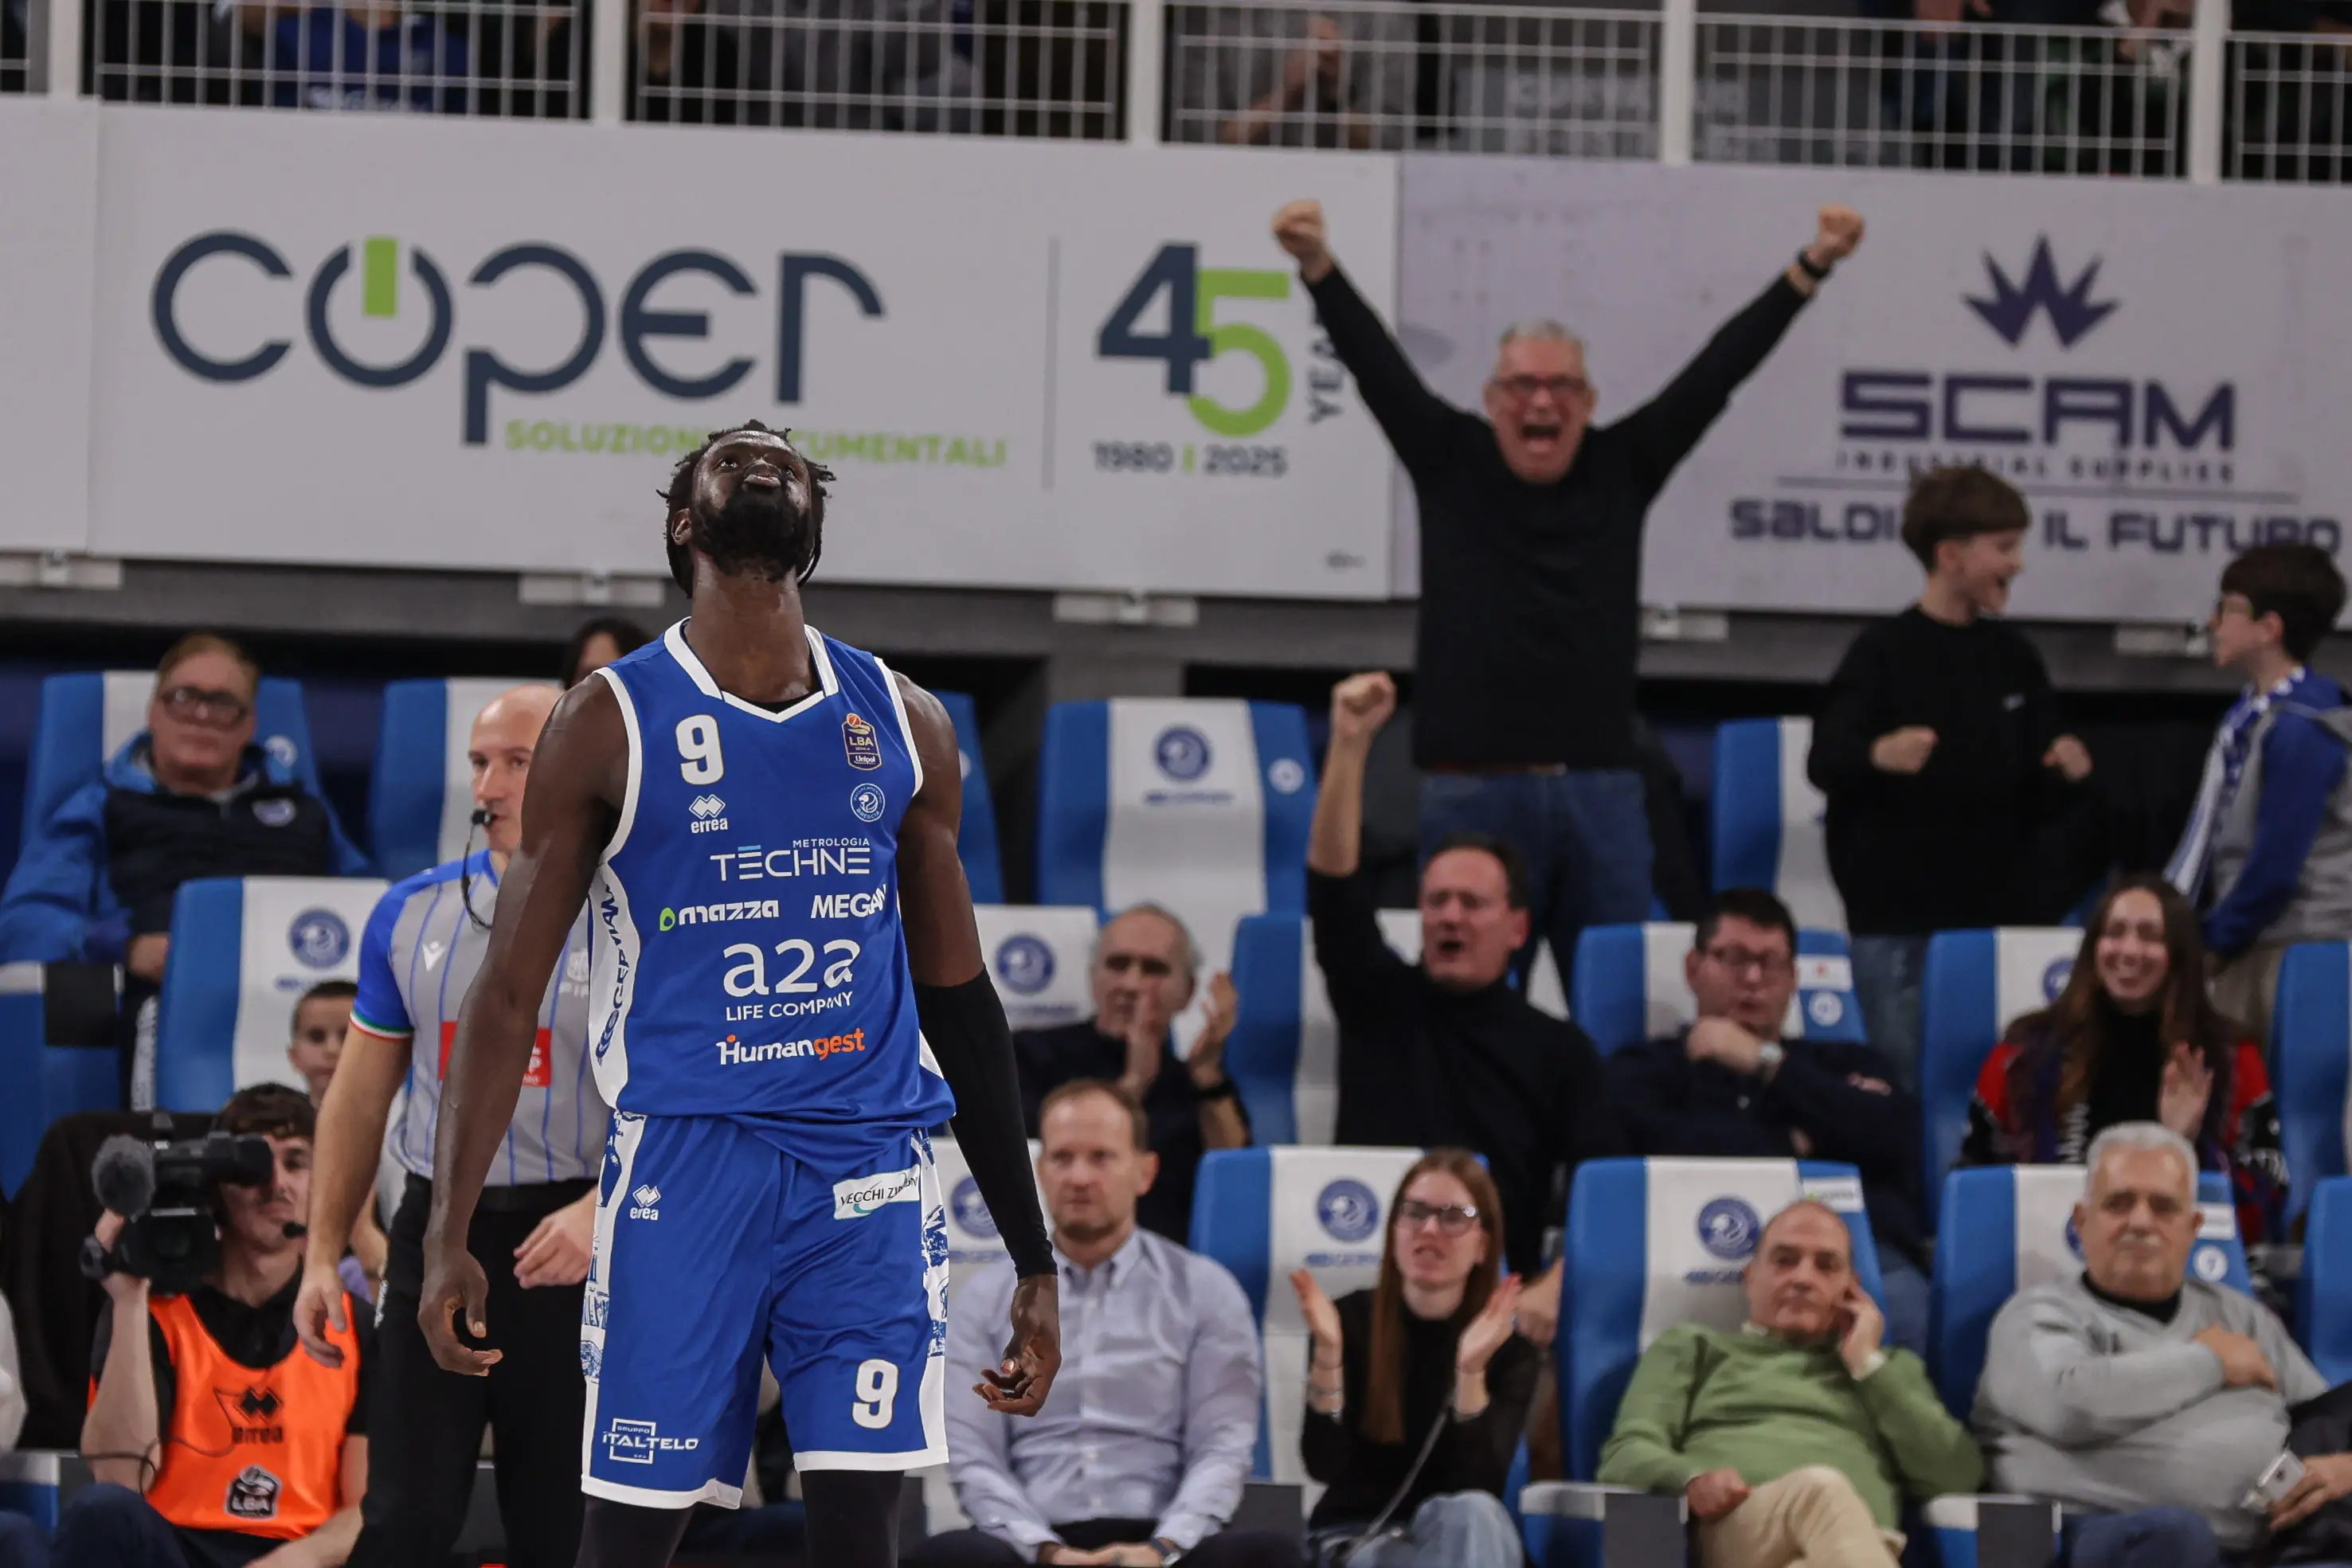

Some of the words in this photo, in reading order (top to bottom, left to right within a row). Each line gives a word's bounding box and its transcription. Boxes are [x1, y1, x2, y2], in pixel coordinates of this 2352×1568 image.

[1098, 243, 1292, 438] 45
[1840, 370, 2235, 452] SCAM
[505, 420, 714, 455] SOLUZION
[787, 430, 1007, 468] CUMENTALI
[1094, 441, 1172, 473] 1980
[1204, 443, 1287, 478] 2025
[2042, 512, 2088, 549] IL
[2111, 511, 2340, 556] FUTURO
[675, 714, 724, 785] 9
[849, 737, 875, 747] LBA
[855, 755, 876, 765] Unipol
[691, 818, 728, 834] errea
[792, 838, 870, 848] METROLOGIA
[710, 845, 871, 882] TECHNE
[679, 900, 779, 925] mazza
[723, 939, 860, 997] a2a
[726, 1005, 764, 1021] LIFE
[716, 1027, 866, 1066] Humangest
[840, 1187, 884, 1205] VECCHI
[852, 1359, 898, 1429] 9
[602, 1432, 699, 1450] ITALTELO
[616, 1425, 650, 1434] GRUPPO
